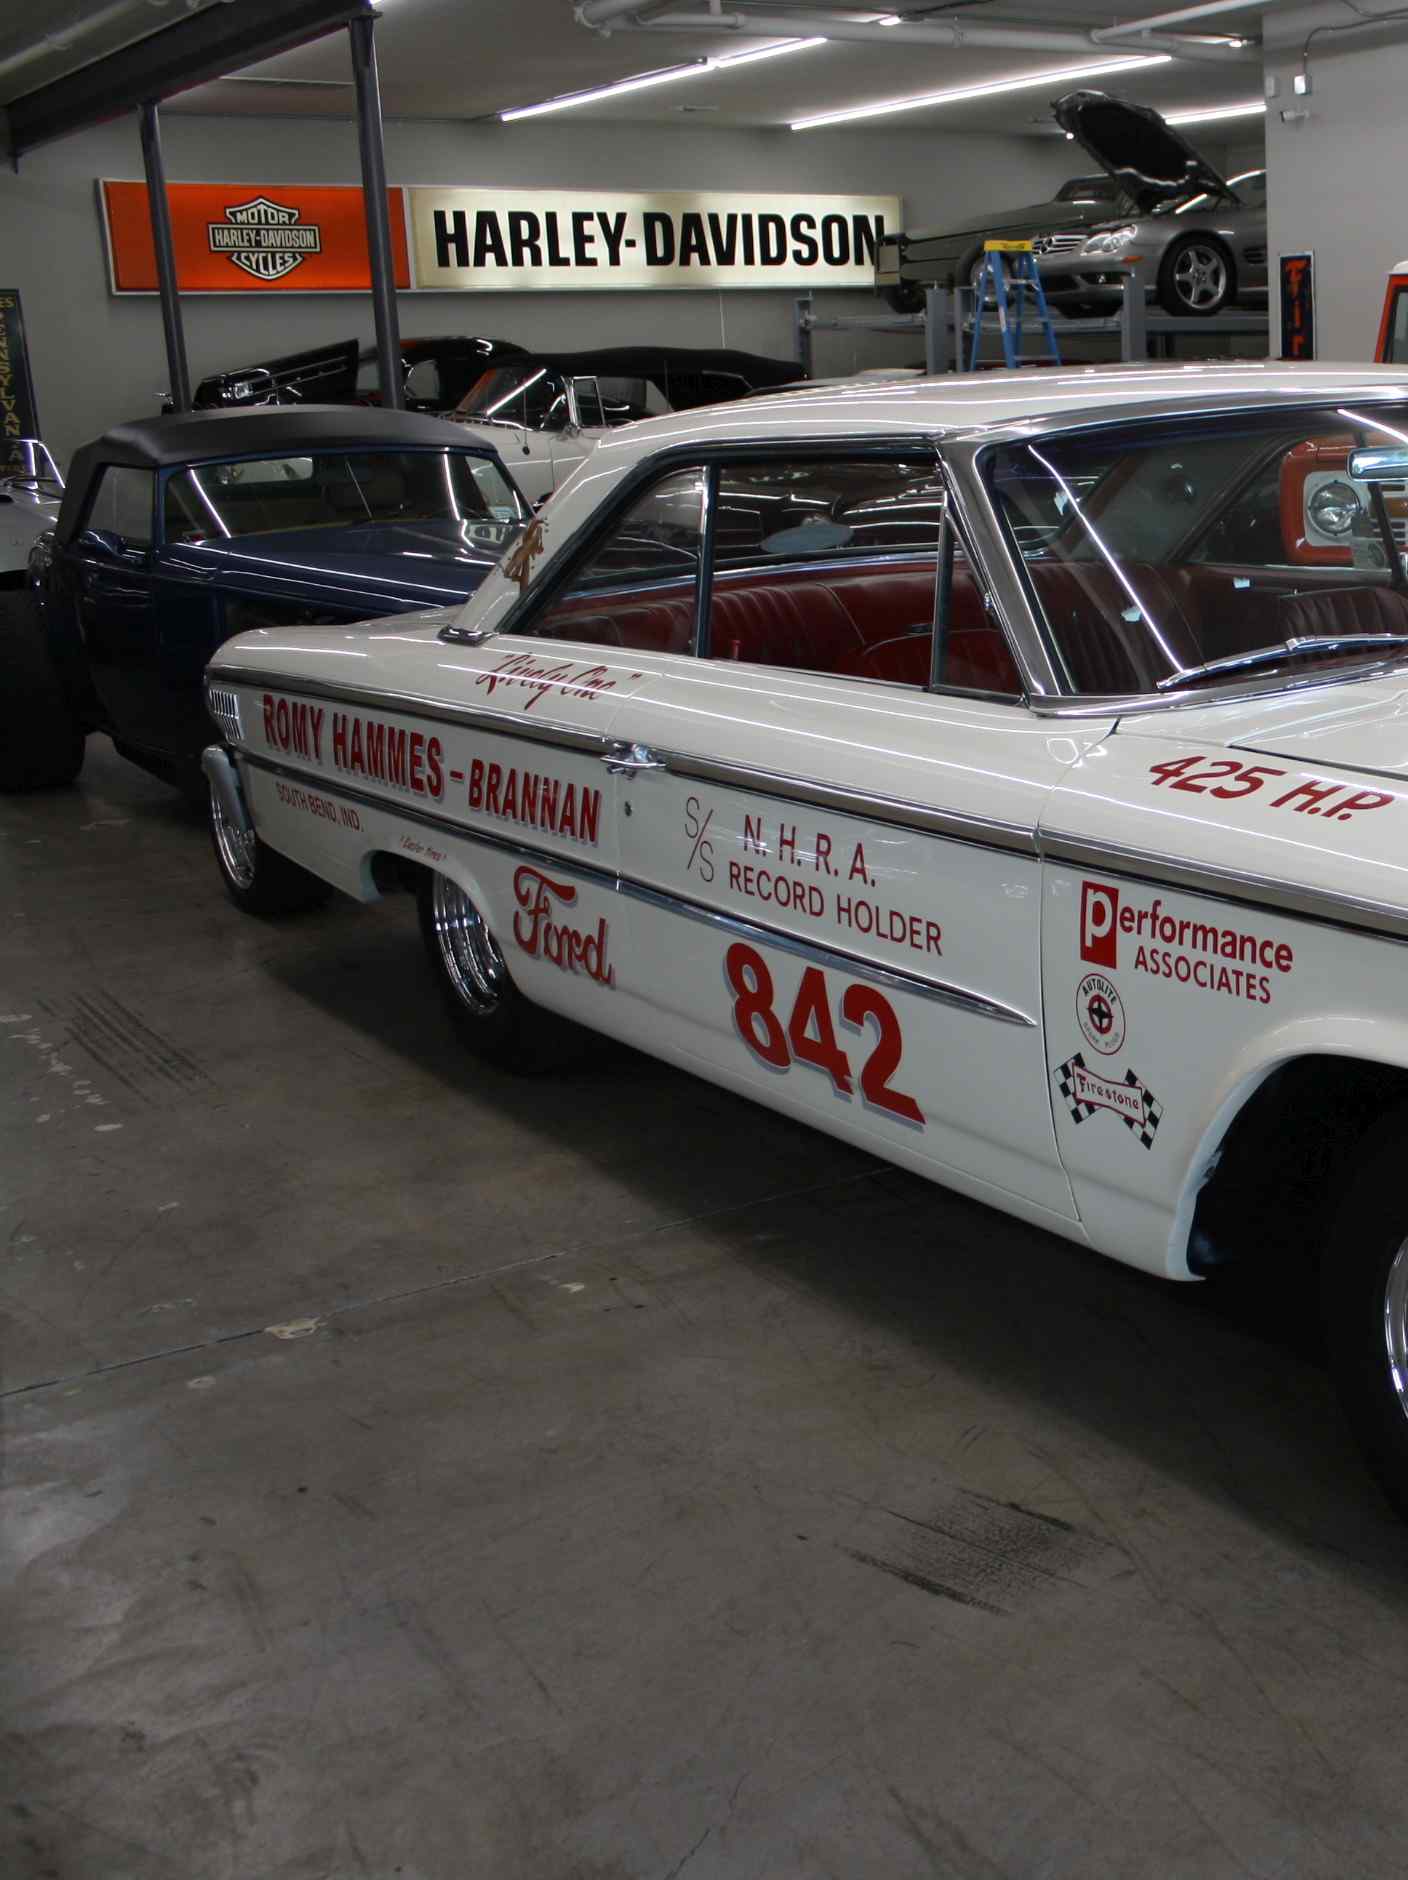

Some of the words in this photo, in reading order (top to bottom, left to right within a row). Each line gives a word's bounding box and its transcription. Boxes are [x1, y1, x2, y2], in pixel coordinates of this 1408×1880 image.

[236, 204, 290, 224] MOTOR
[214, 228, 315, 248] HARLEY-DAVIDSON
[433, 210, 884, 267] HARLEY-DAVIDSON
[241, 252, 294, 275] CYCLES
[263, 694, 324, 762] ROMY
[276, 781, 310, 811] SOUTH
[1150, 755, 1288, 799] 425
[513, 865, 612, 985] Ford
[729, 860, 825, 917] RECORD
[836, 893, 943, 956] HOLDER
[1082, 977, 1117, 1006] AUTOLITE
[1134, 945, 1272, 1005] ASSOCIATES
[725, 942, 927, 1127] 842
[1075, 1072, 1140, 1110] Firestone
